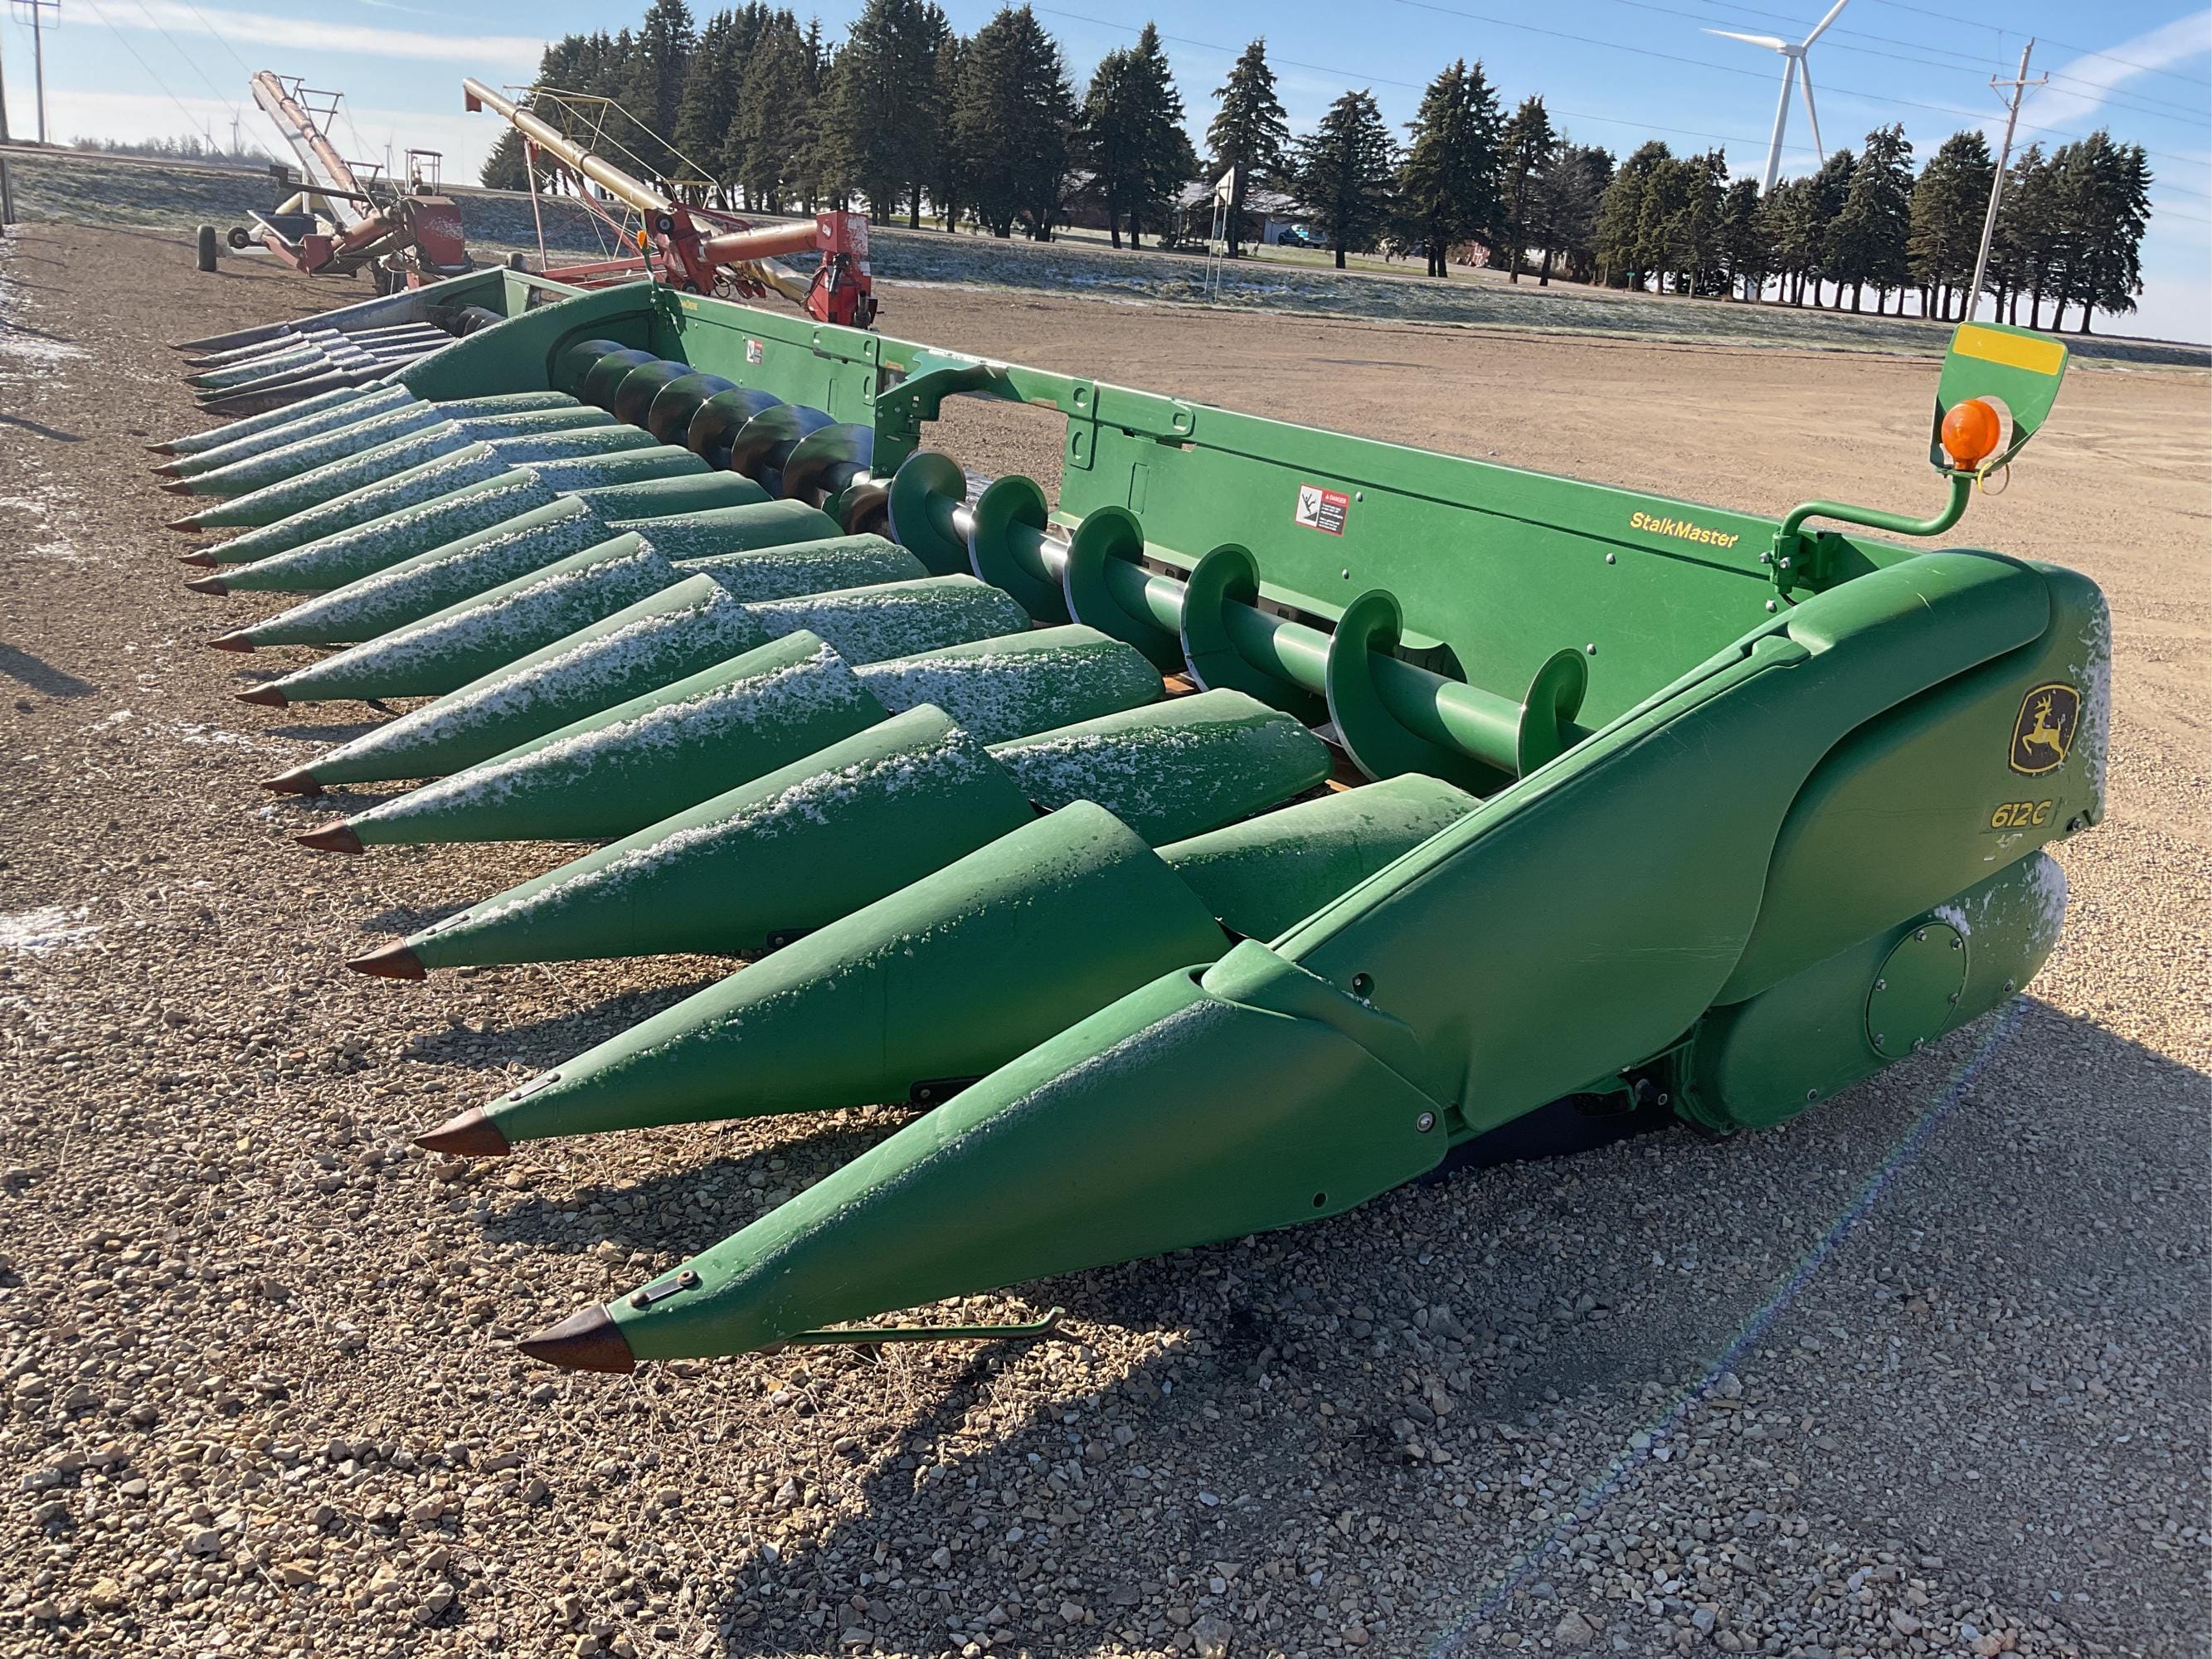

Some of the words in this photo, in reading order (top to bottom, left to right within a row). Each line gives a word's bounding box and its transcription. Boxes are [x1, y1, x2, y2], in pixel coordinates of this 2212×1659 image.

[1329, 494, 1346, 504] DANGER
[1630, 511, 1739, 548] StalkMaster
[1991, 800, 2052, 828] 612C
